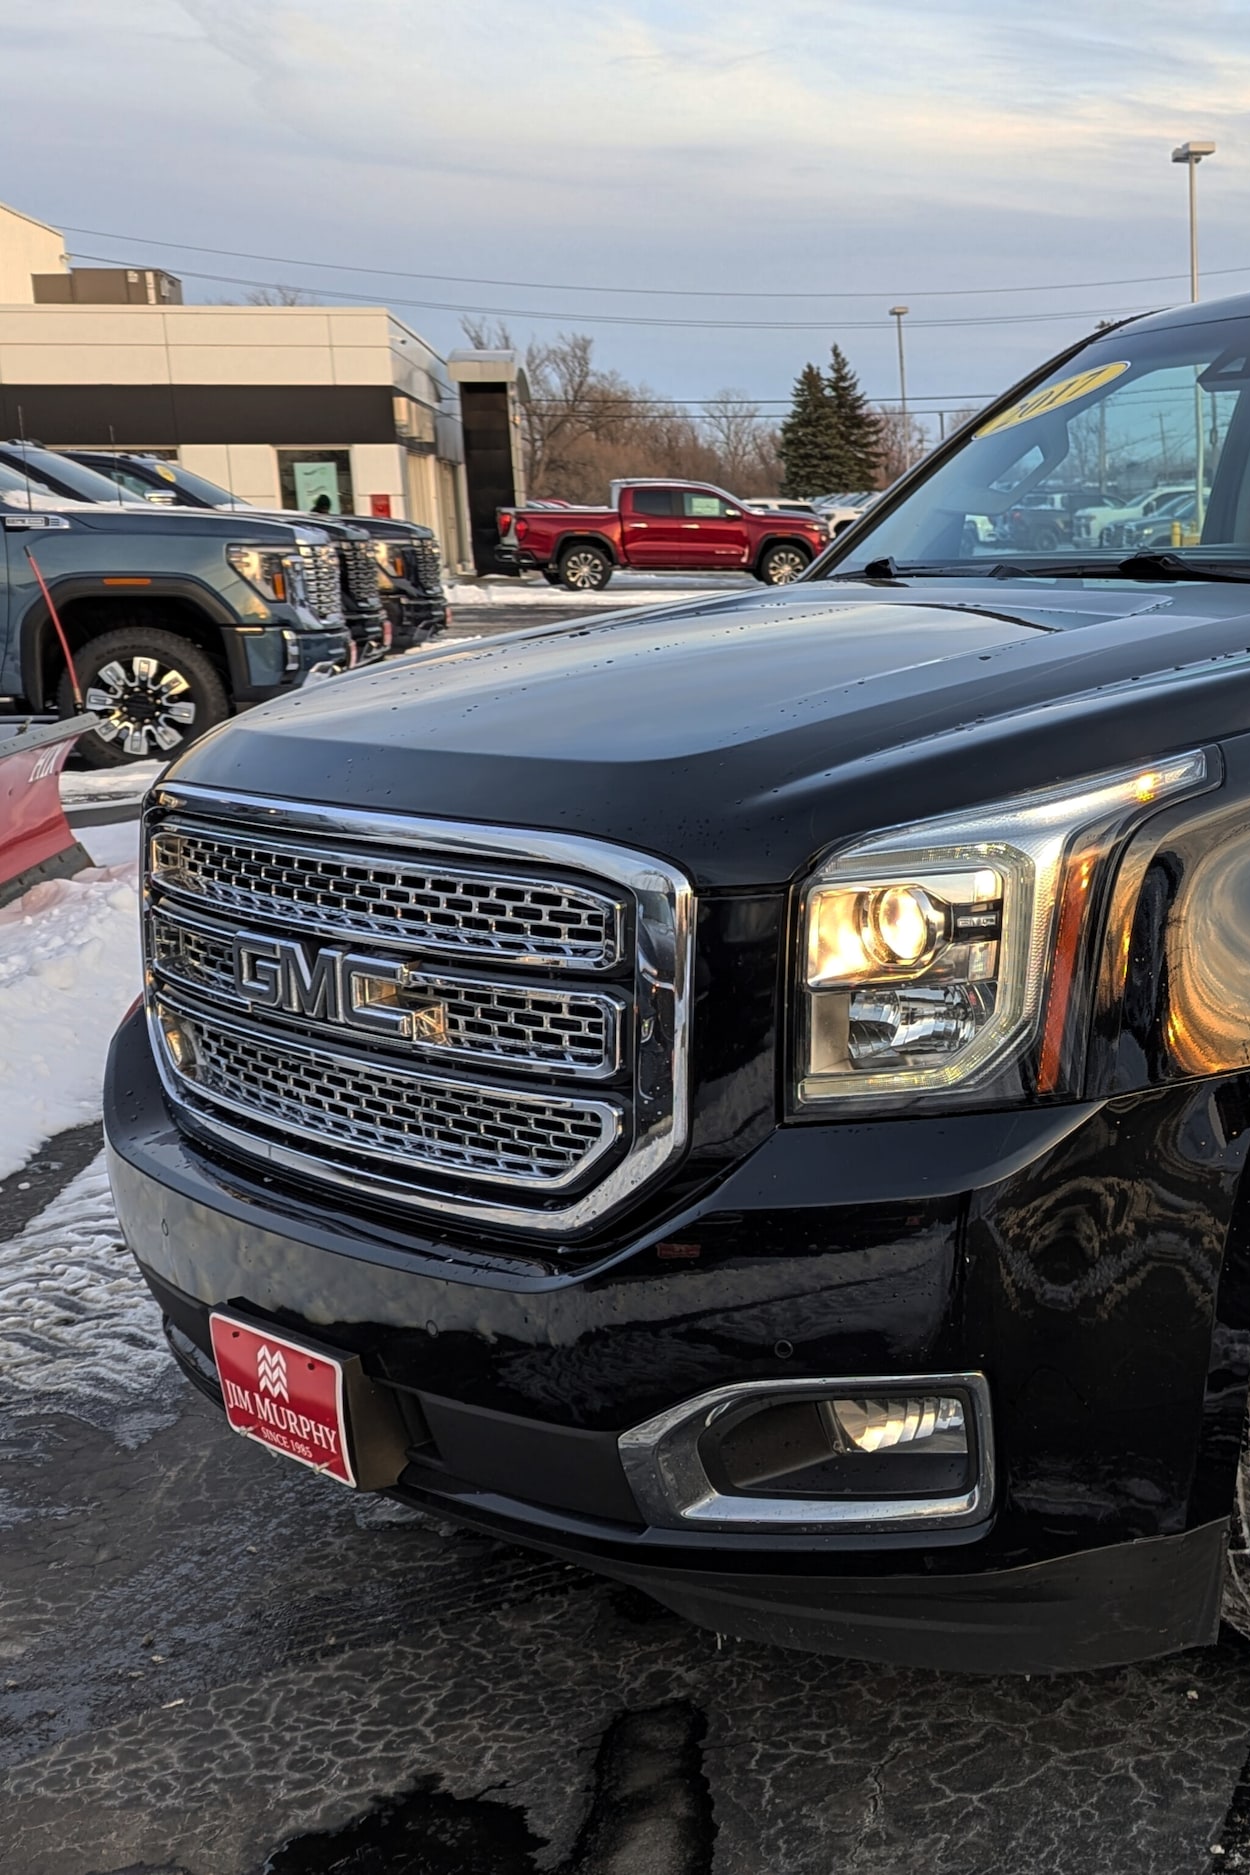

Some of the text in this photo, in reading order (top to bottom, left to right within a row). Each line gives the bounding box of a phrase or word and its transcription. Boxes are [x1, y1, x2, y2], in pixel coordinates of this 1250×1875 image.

[232, 930, 415, 1040] GMC
[225, 1379, 338, 1454] JIM MURPHY
[261, 1426, 313, 1458] SINCE 1985
